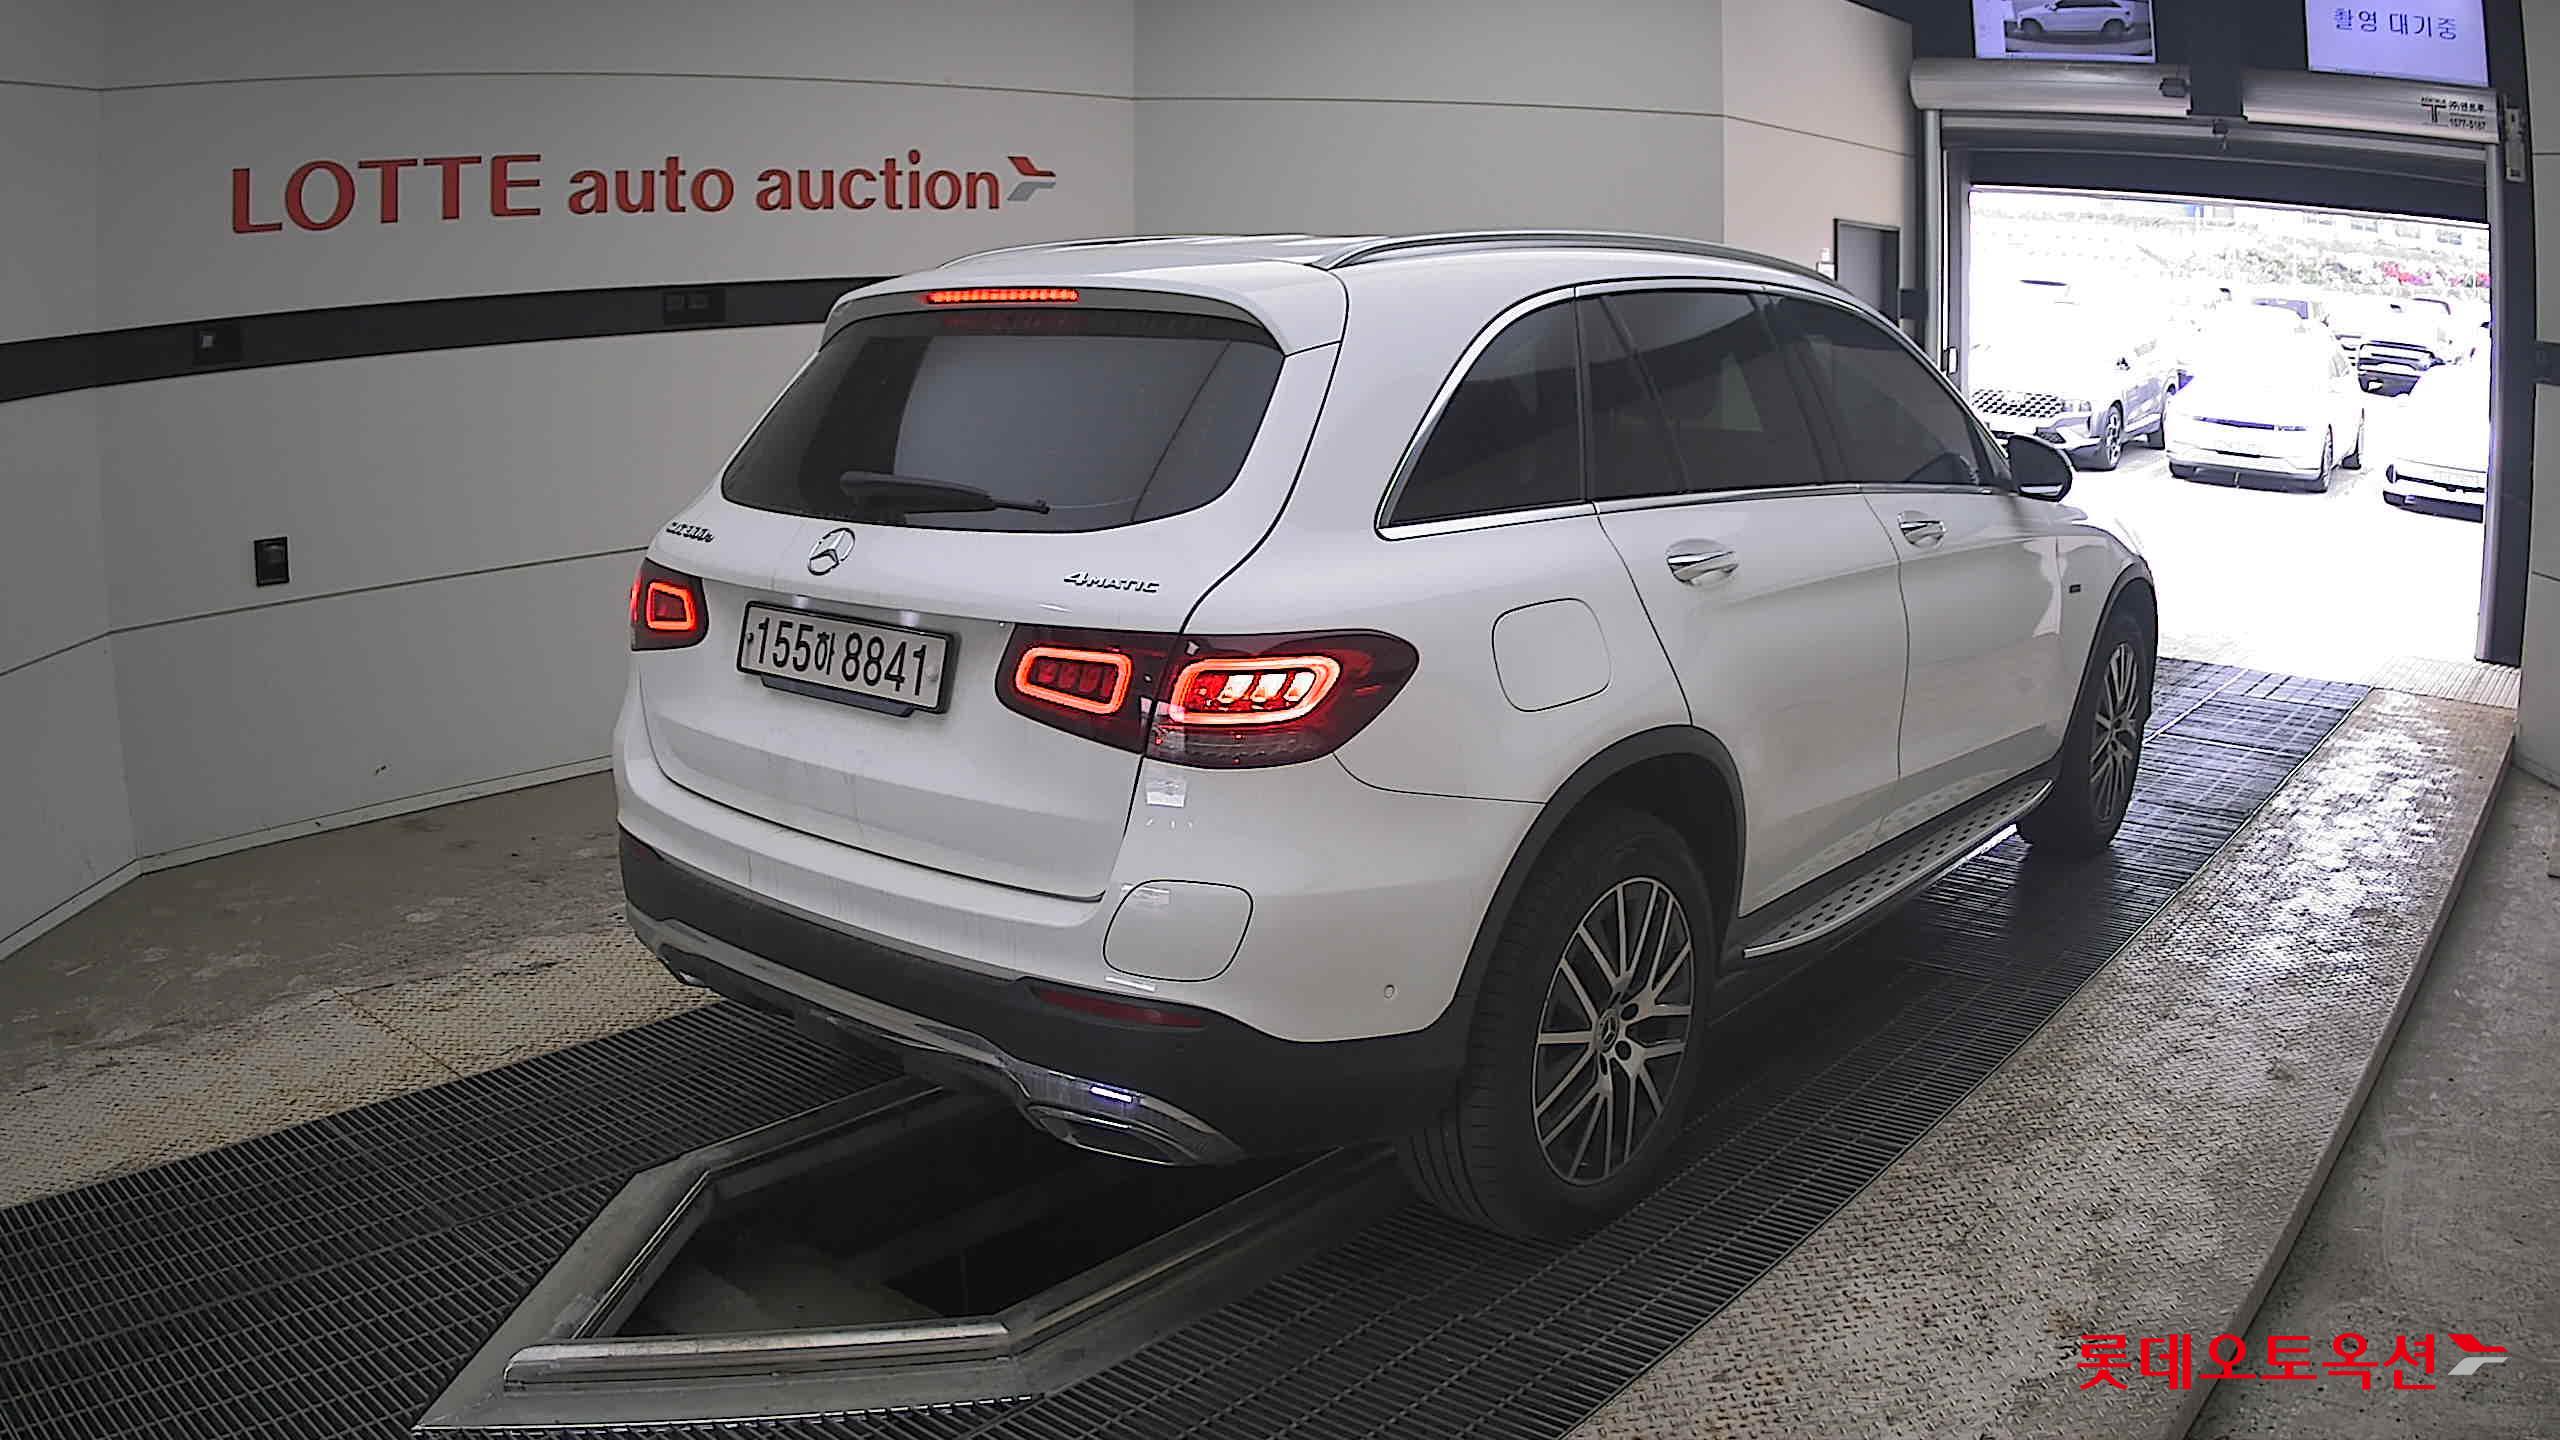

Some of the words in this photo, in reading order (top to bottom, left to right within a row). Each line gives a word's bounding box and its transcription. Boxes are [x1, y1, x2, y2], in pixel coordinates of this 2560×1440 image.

[2389, 13, 2457, 41] 대기중
[231, 155, 541, 235] LOTTE
[568, 156, 737, 215] auto
[755, 150, 1003, 214] auction
[1063, 573, 1161, 593] 4MATIC
[758, 617, 835, 675] 155하
[841, 632, 927, 696] 8841
